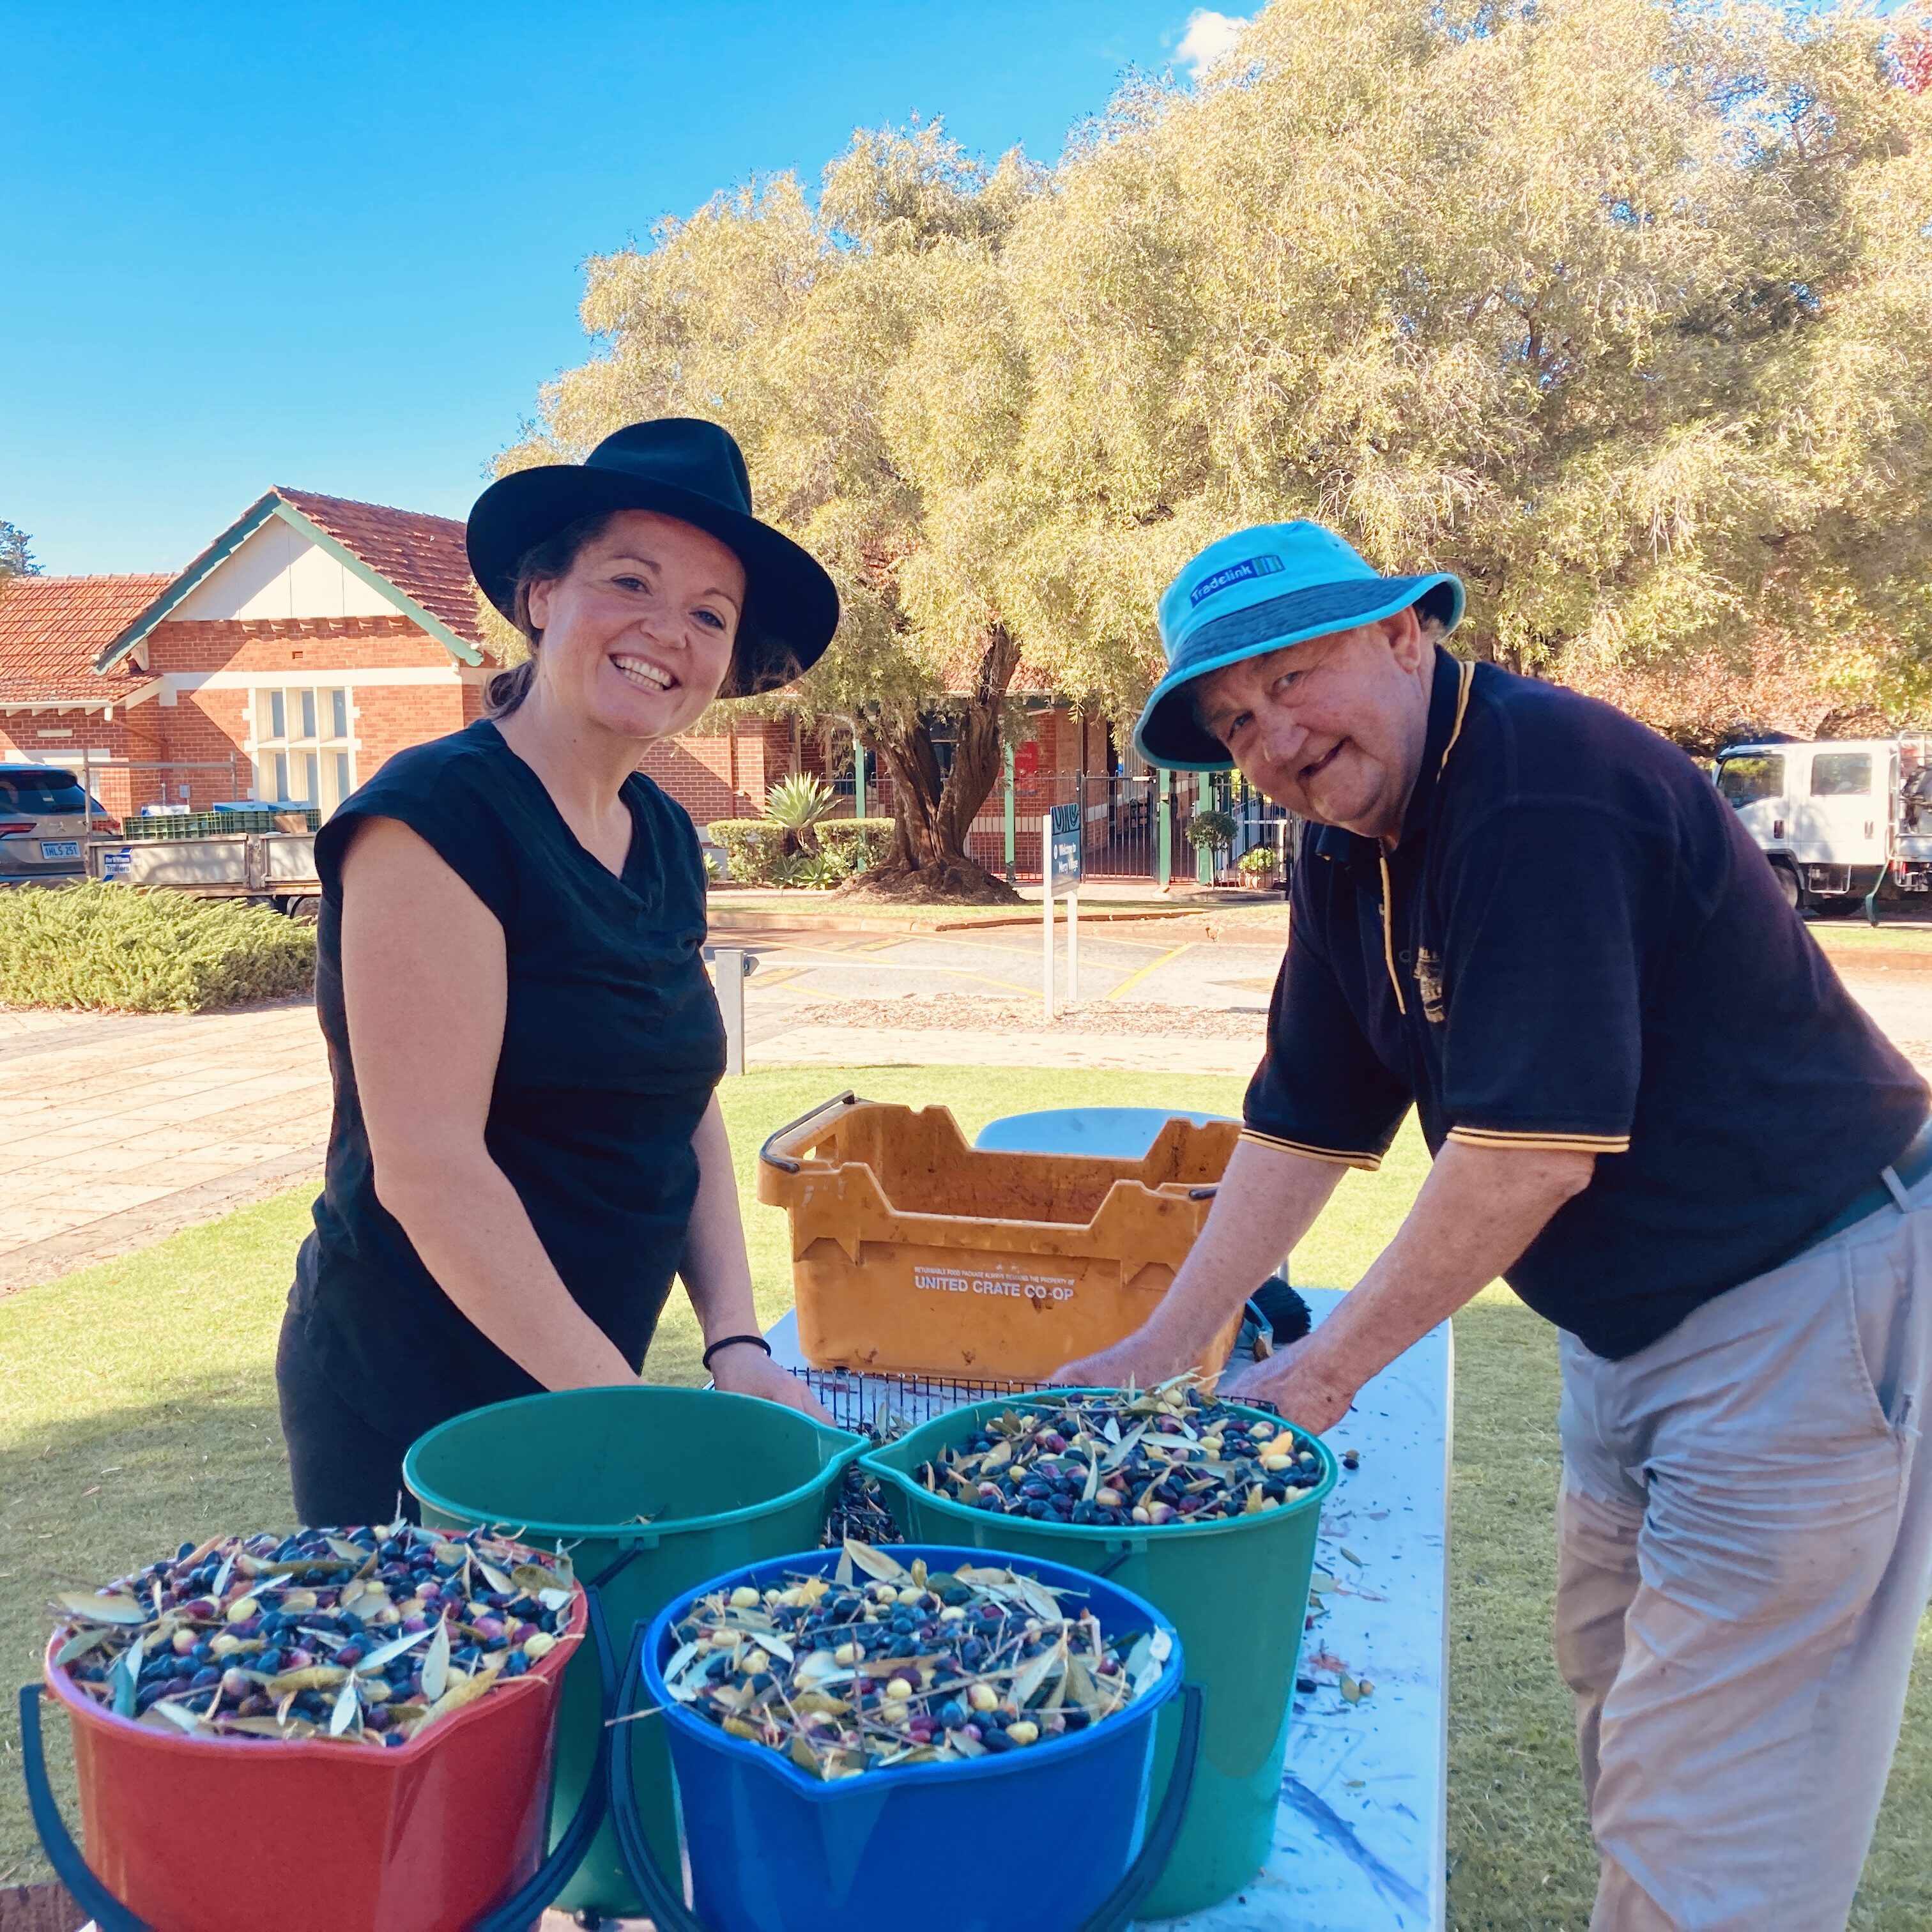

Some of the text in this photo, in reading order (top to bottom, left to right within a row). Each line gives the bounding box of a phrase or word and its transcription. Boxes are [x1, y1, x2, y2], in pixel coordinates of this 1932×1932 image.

[1192, 565, 1253, 601] Tradelink
[65, 846, 77, 855] 251
[1059, 843, 1077, 856] Welcome to
[1059, 858, 1078, 874] Mercy Village
[962, 1270, 984, 1278] PACKAGE
[1039, 1276, 1067, 1285] PROPERTY
[915, 1276, 1074, 1300] UNITED CRATE CO-OP
